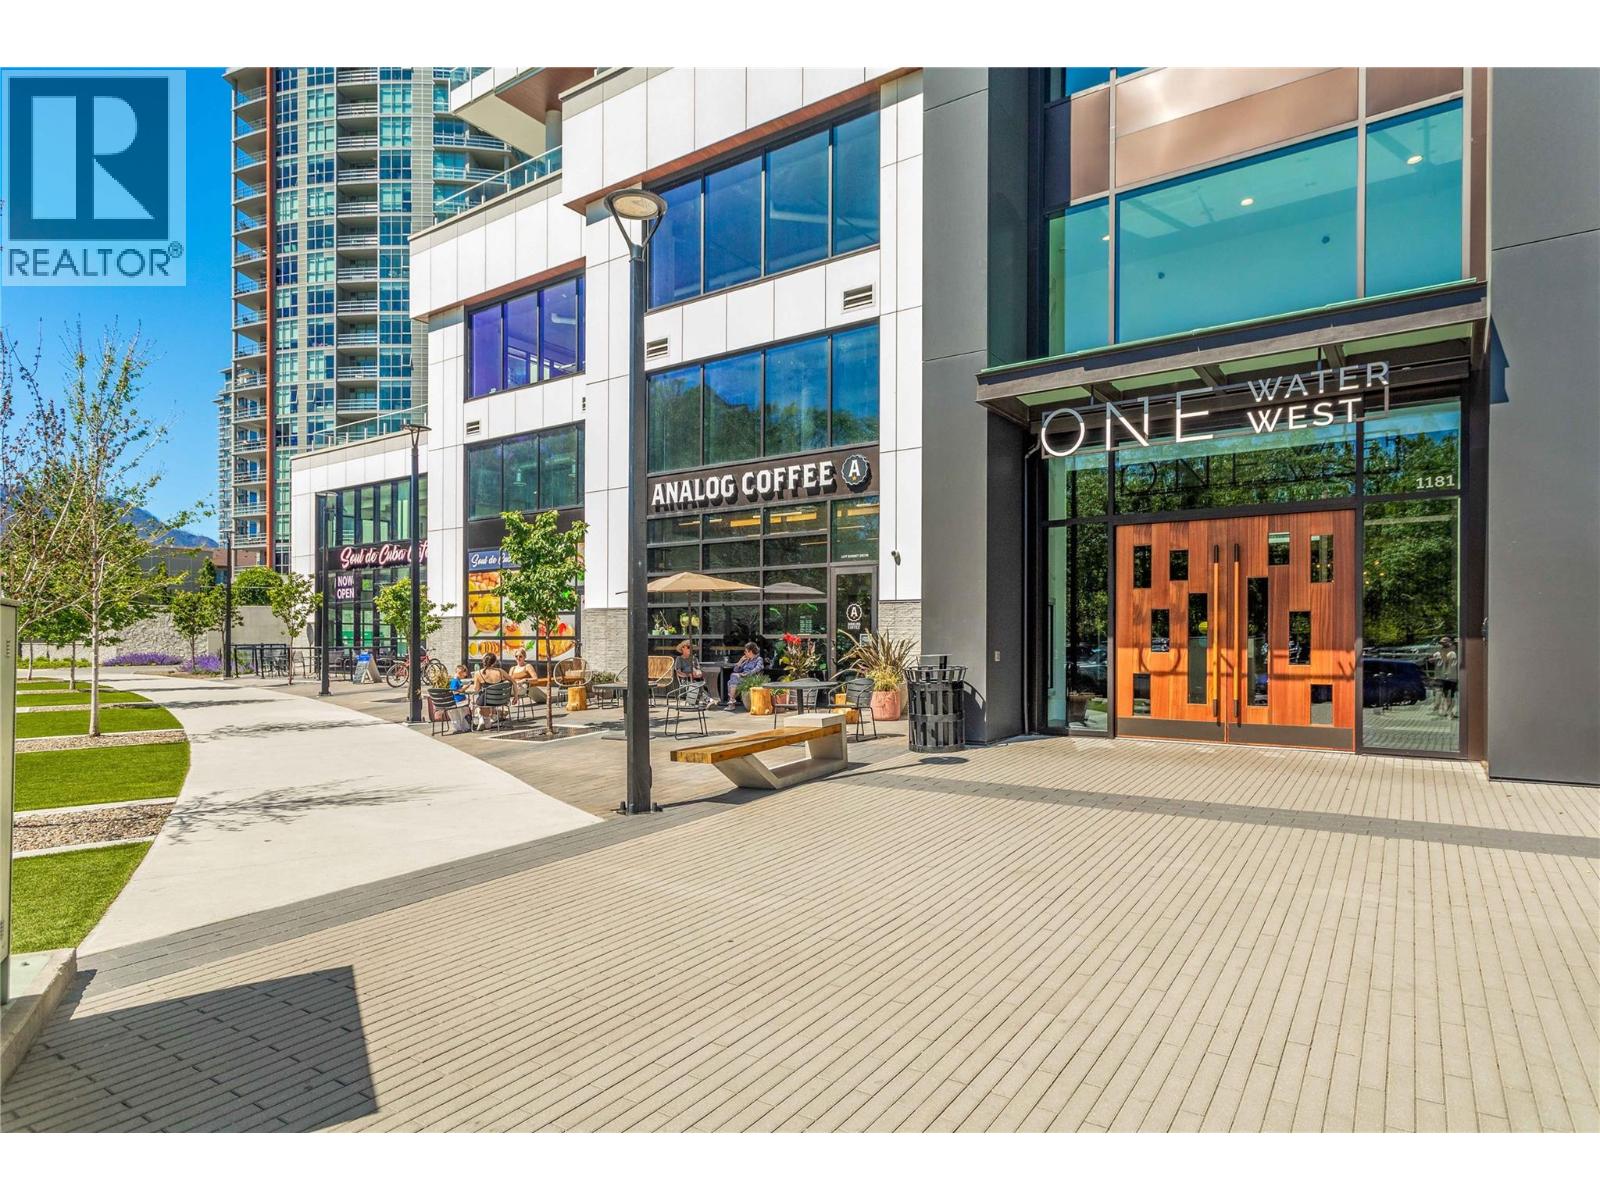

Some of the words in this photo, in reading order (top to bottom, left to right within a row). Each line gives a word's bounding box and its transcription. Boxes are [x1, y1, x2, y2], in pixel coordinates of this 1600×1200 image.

[1247, 360, 1390, 402] WATER
[1040, 386, 1215, 457] ONE
[1246, 397, 1363, 434] WEST
[651, 474, 737, 507] ANALOG
[741, 460, 835, 496] COFFEE
[1415, 475, 1455, 489] 1181
[379, 543, 407, 565] Cuba
[336, 587, 354, 599] OPEN
[337, 575, 354, 587] NOW
